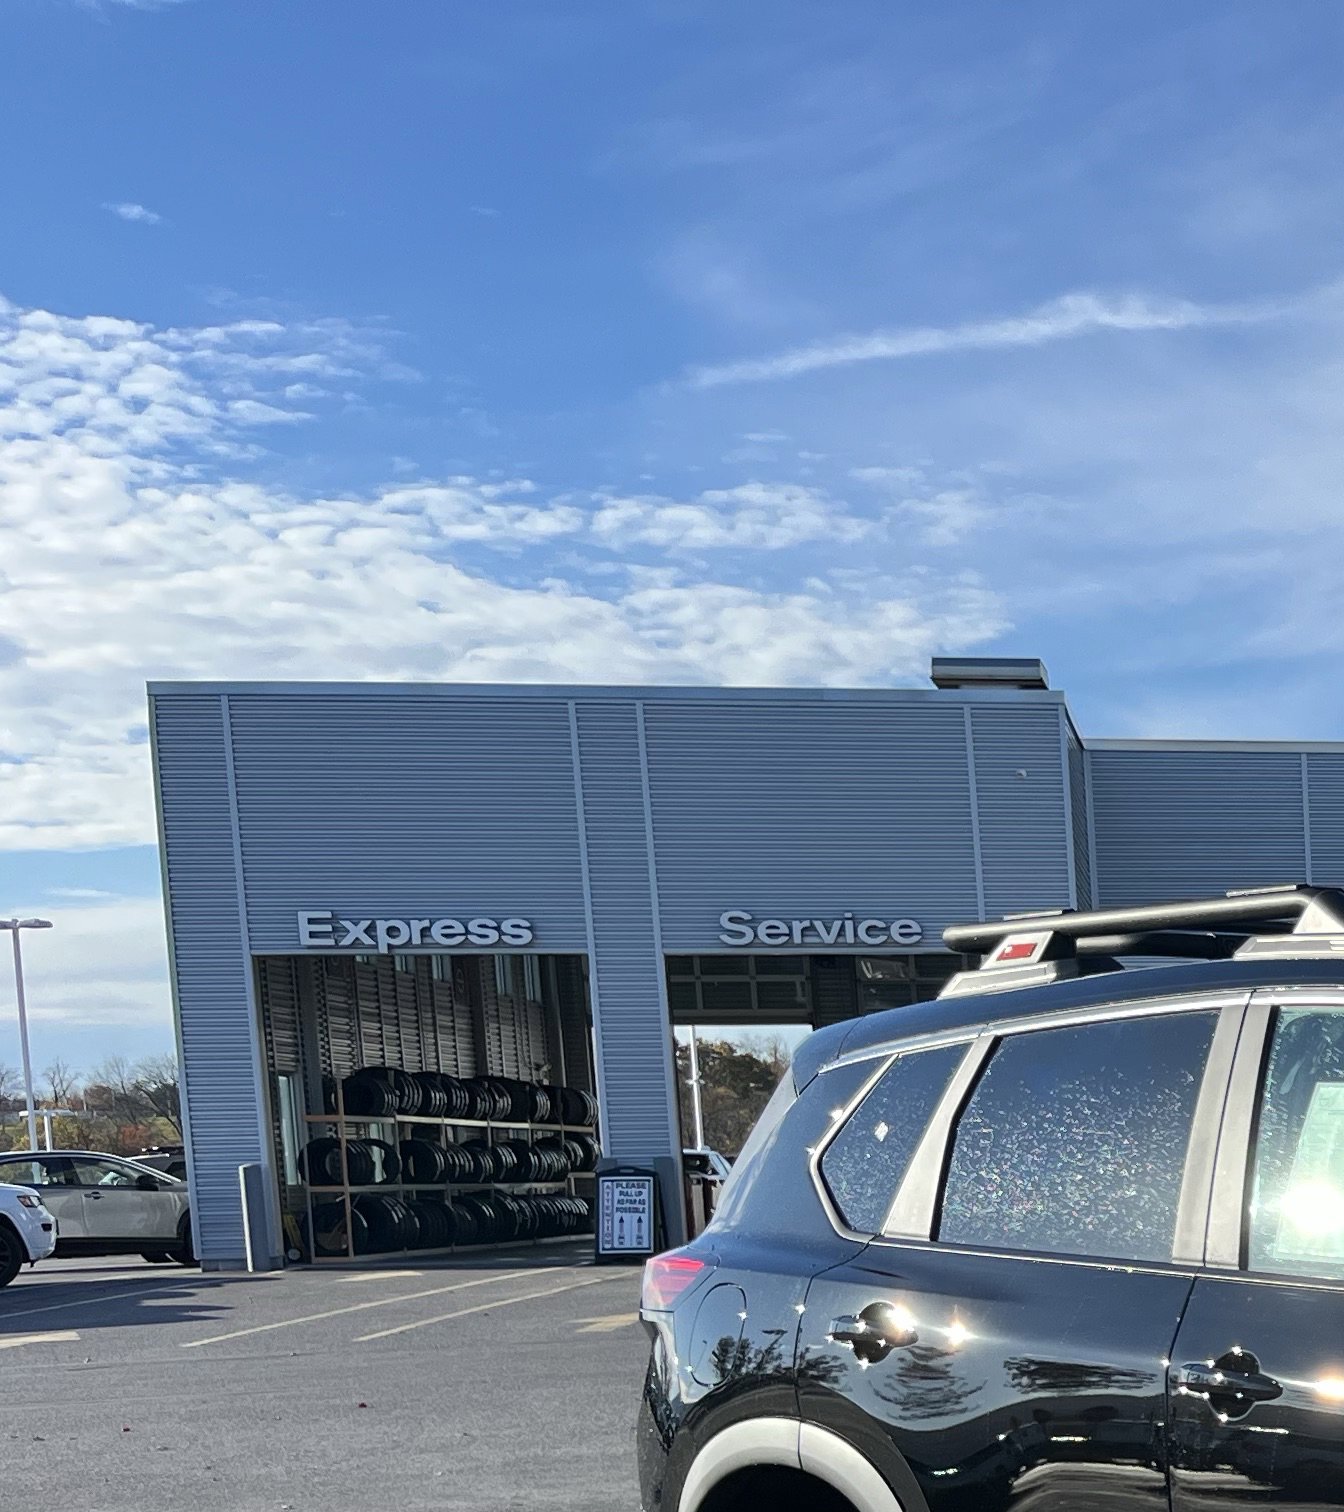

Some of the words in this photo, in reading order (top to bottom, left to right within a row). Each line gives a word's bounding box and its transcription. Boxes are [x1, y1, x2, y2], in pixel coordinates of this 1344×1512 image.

[297, 910, 534, 954] Express
[718, 910, 923, 946] Service
[615, 1182, 647, 1190] PLEASE
